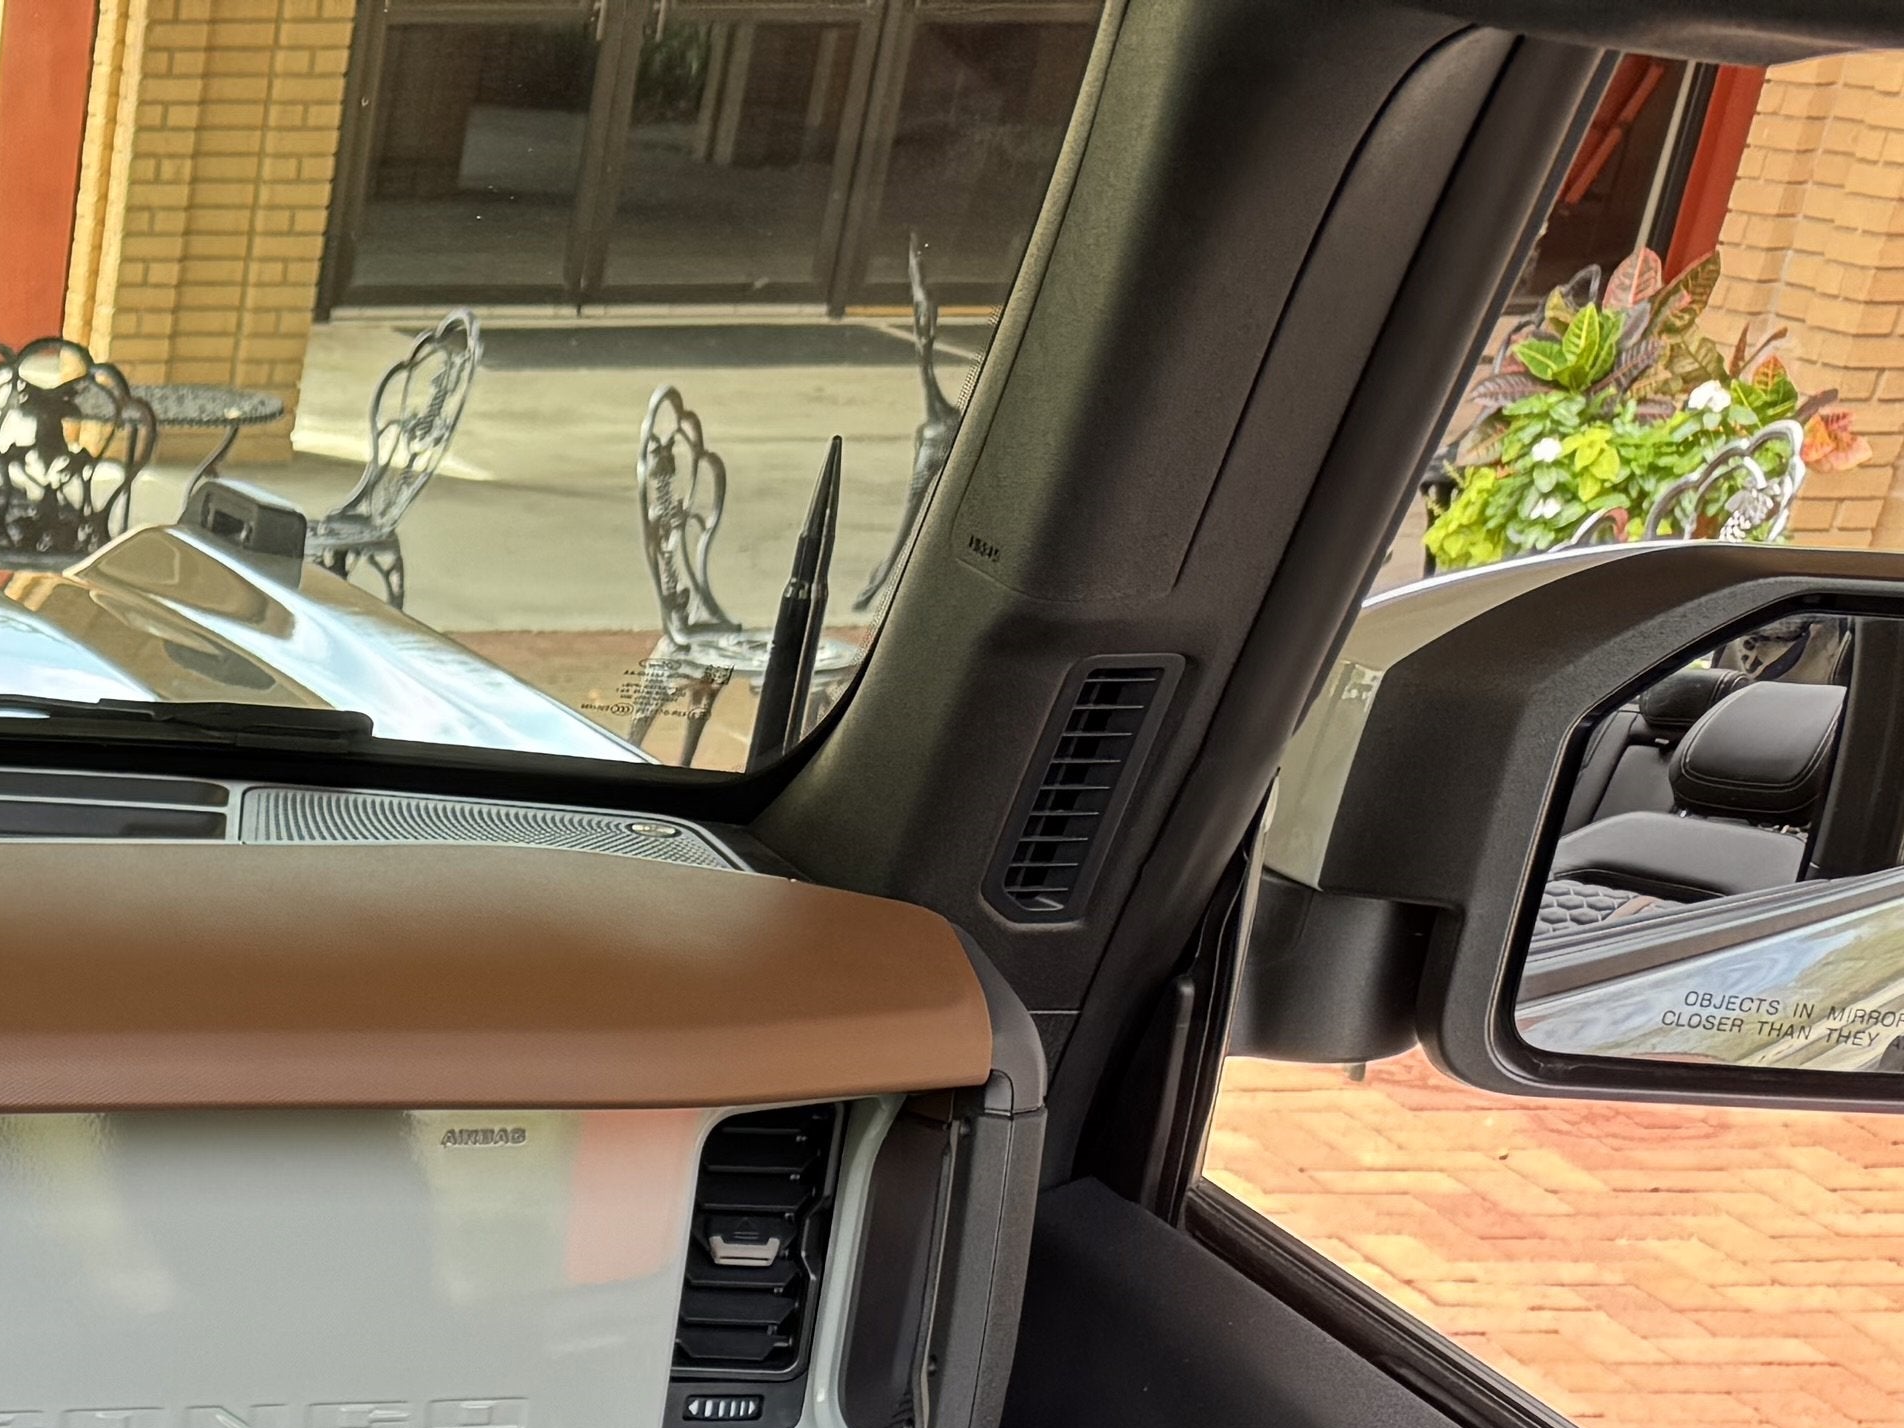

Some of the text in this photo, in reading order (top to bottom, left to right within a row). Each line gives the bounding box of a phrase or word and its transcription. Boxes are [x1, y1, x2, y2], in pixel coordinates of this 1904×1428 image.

[1684, 990, 1781, 1016] OBJECTS
[1793, 1002, 1815, 1019] IN
[1661, 1010, 1745, 1033] CLOSER
[1757, 1021, 1812, 1041] THAN
[1826, 1027, 1881, 1048] THEY
